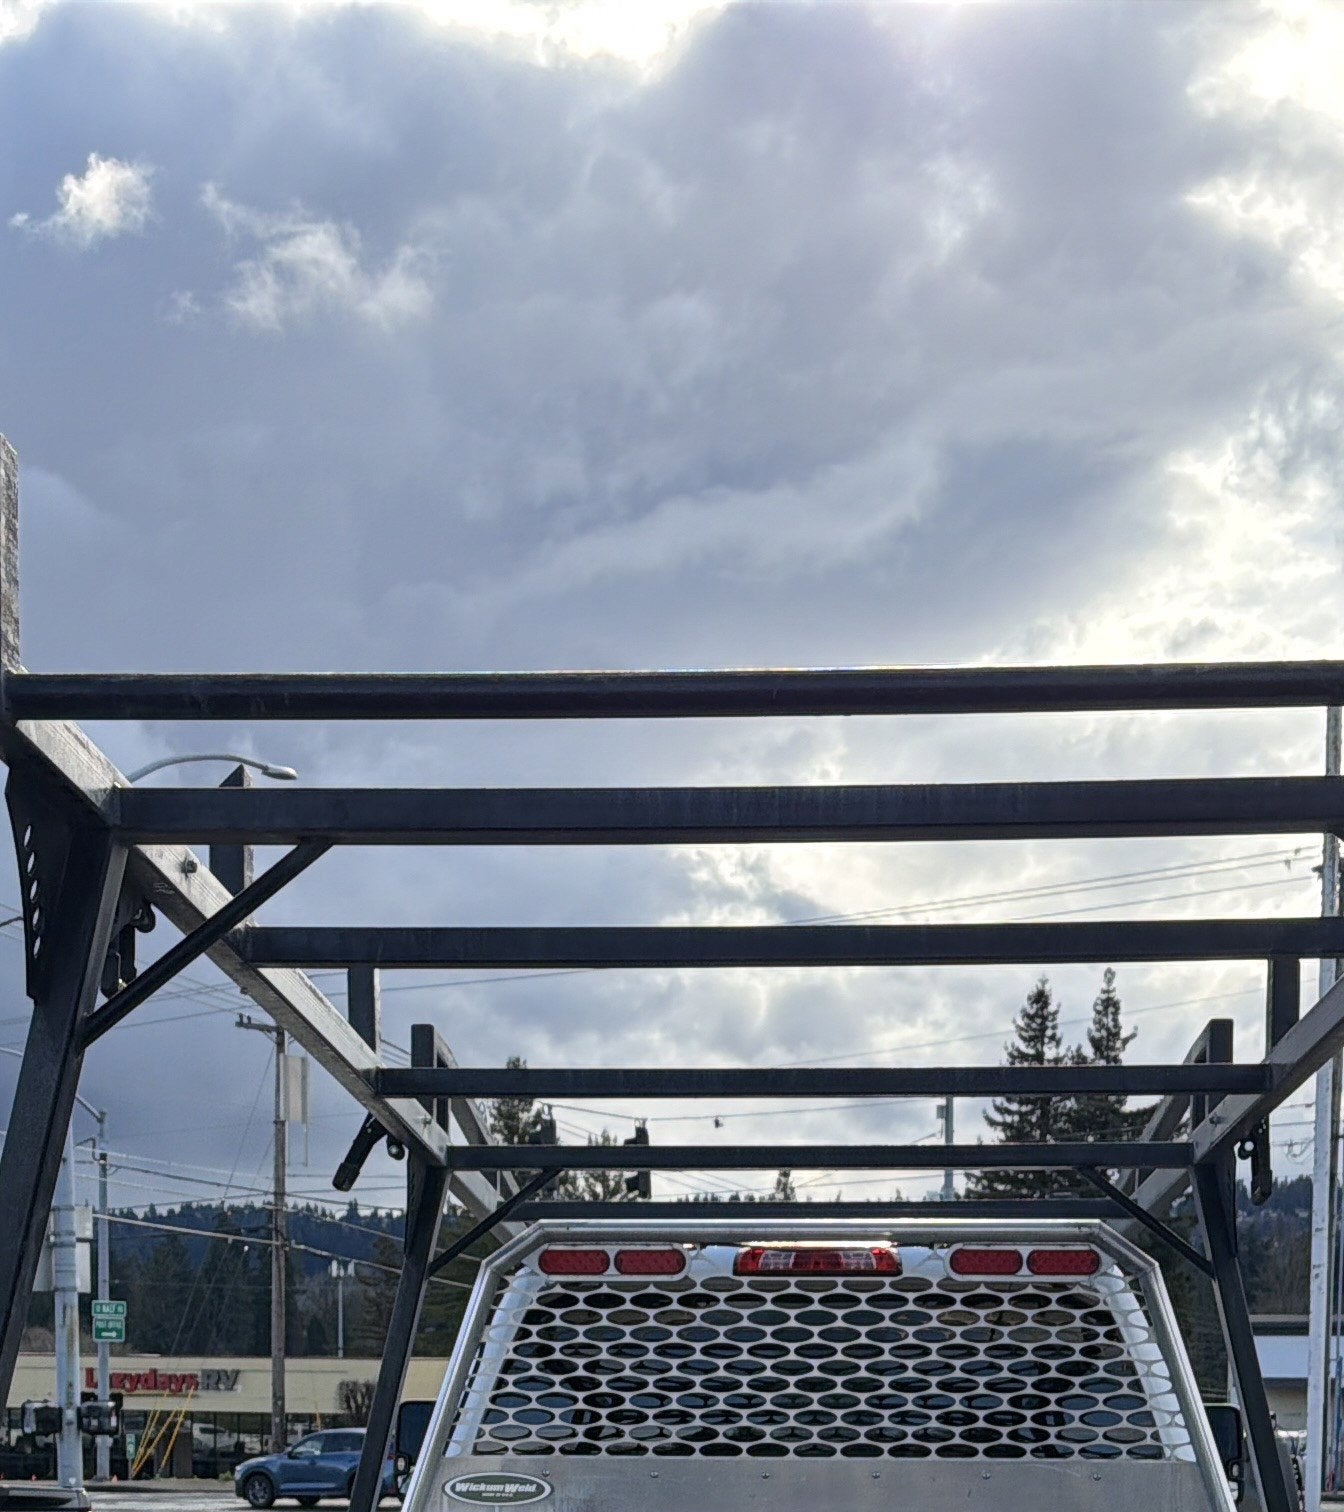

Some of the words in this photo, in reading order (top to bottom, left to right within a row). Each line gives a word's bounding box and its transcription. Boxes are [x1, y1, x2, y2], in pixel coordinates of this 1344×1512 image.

[85, 1367, 200, 1393] Lzydays
[201, 1369, 241, 1391] RV
[455, 1482, 504, 1492] Wickum
[505, 1483, 537, 1493] Weld
